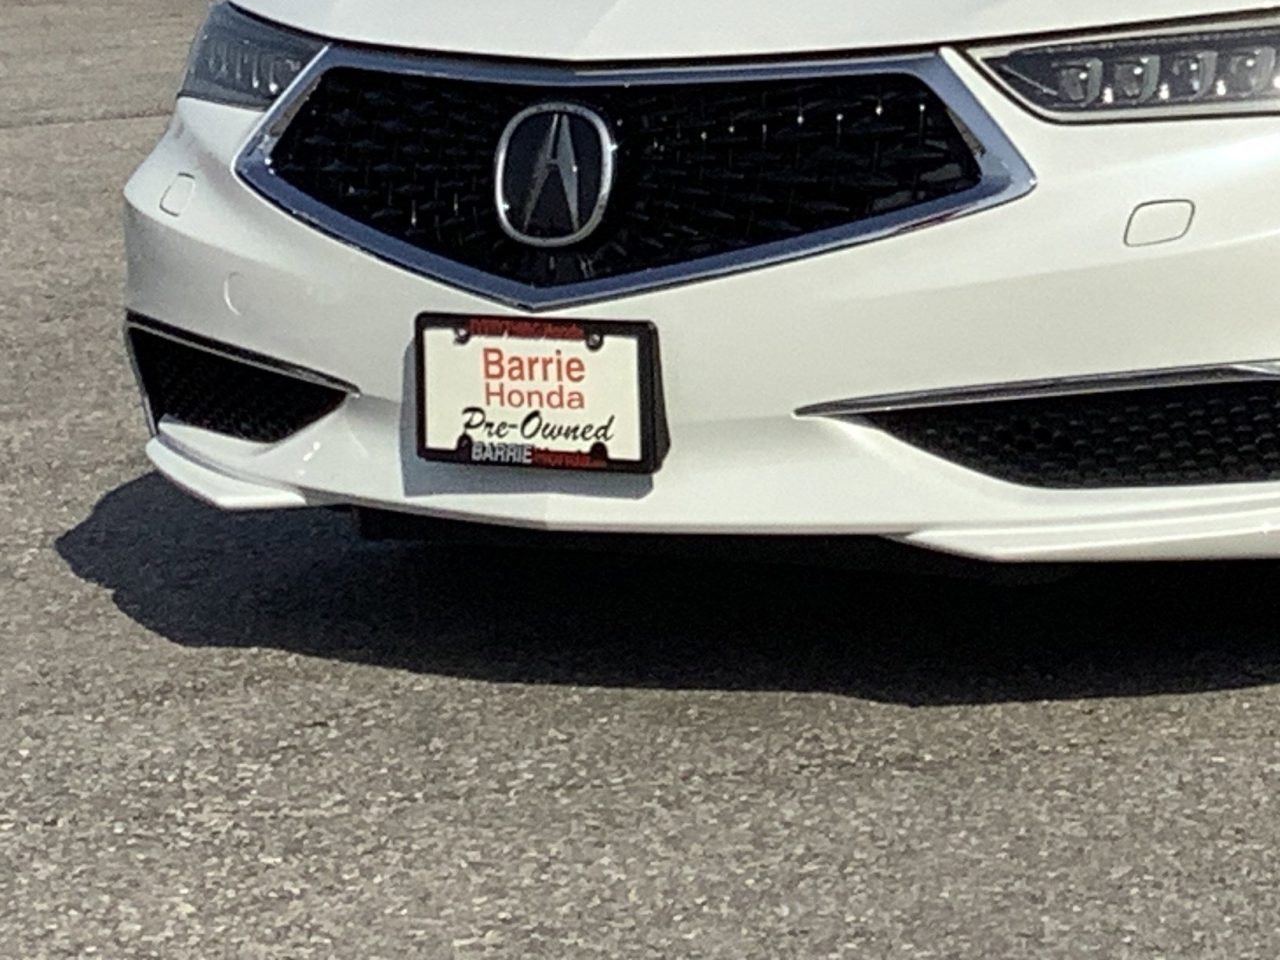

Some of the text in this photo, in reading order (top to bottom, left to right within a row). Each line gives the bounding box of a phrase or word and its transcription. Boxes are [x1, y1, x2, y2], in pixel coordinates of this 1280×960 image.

[483, 348, 586, 382] Barrie
[485, 383, 585, 409] Honda
[462, 407, 615, 441] Pre-Owned
[471, 442, 533, 465] BARRIE
